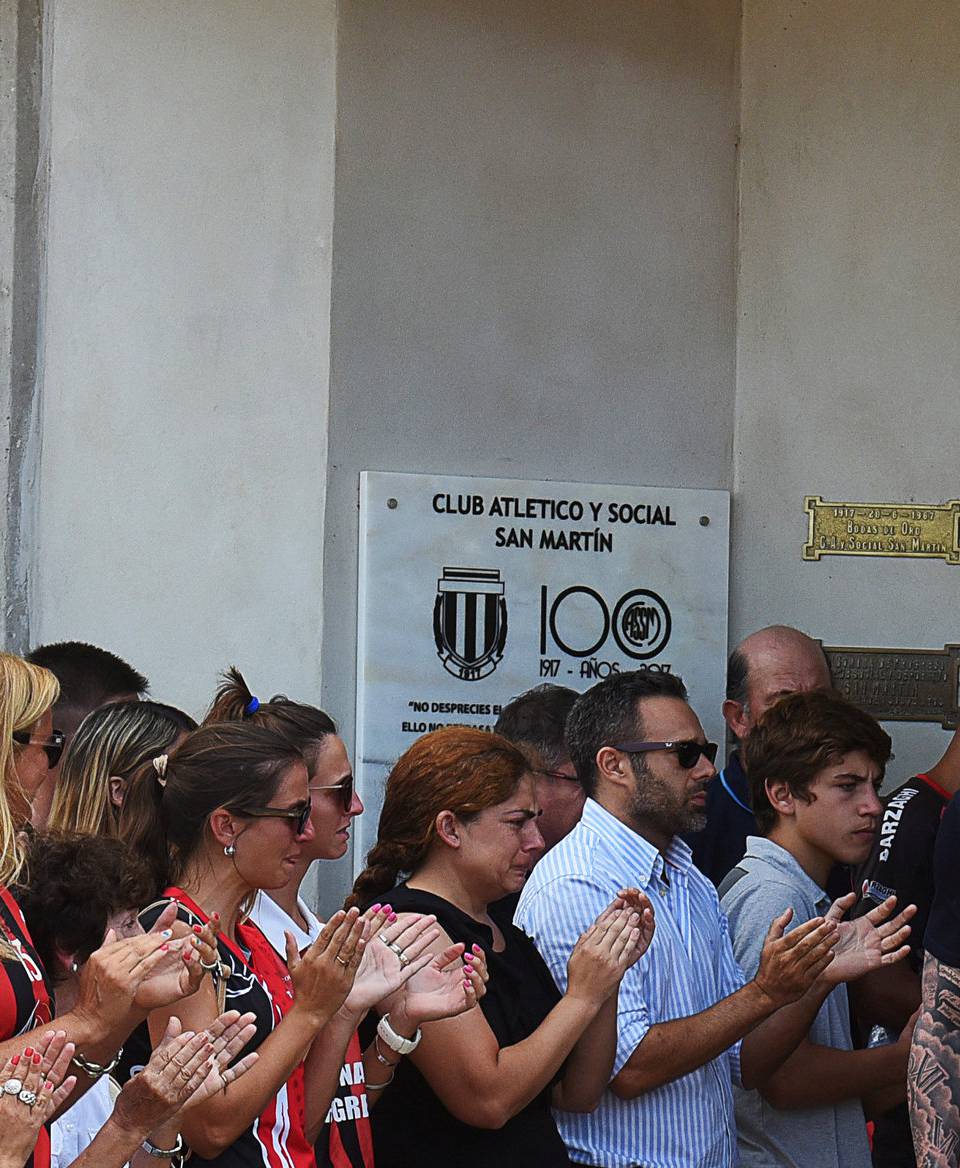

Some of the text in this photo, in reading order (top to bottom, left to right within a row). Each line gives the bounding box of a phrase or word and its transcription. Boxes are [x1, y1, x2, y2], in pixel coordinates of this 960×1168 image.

[432, 493, 677, 526] CLUB ATLETICO Y SOCIAL
[495, 527, 613, 552] SAN MARTÍN
[539, 659, 560, 677] 1917
[580, 657, 620, 679] AÑOS
[431, 703, 491, 715] DESPRECIES
[401, 722, 426, 732] ELLO
